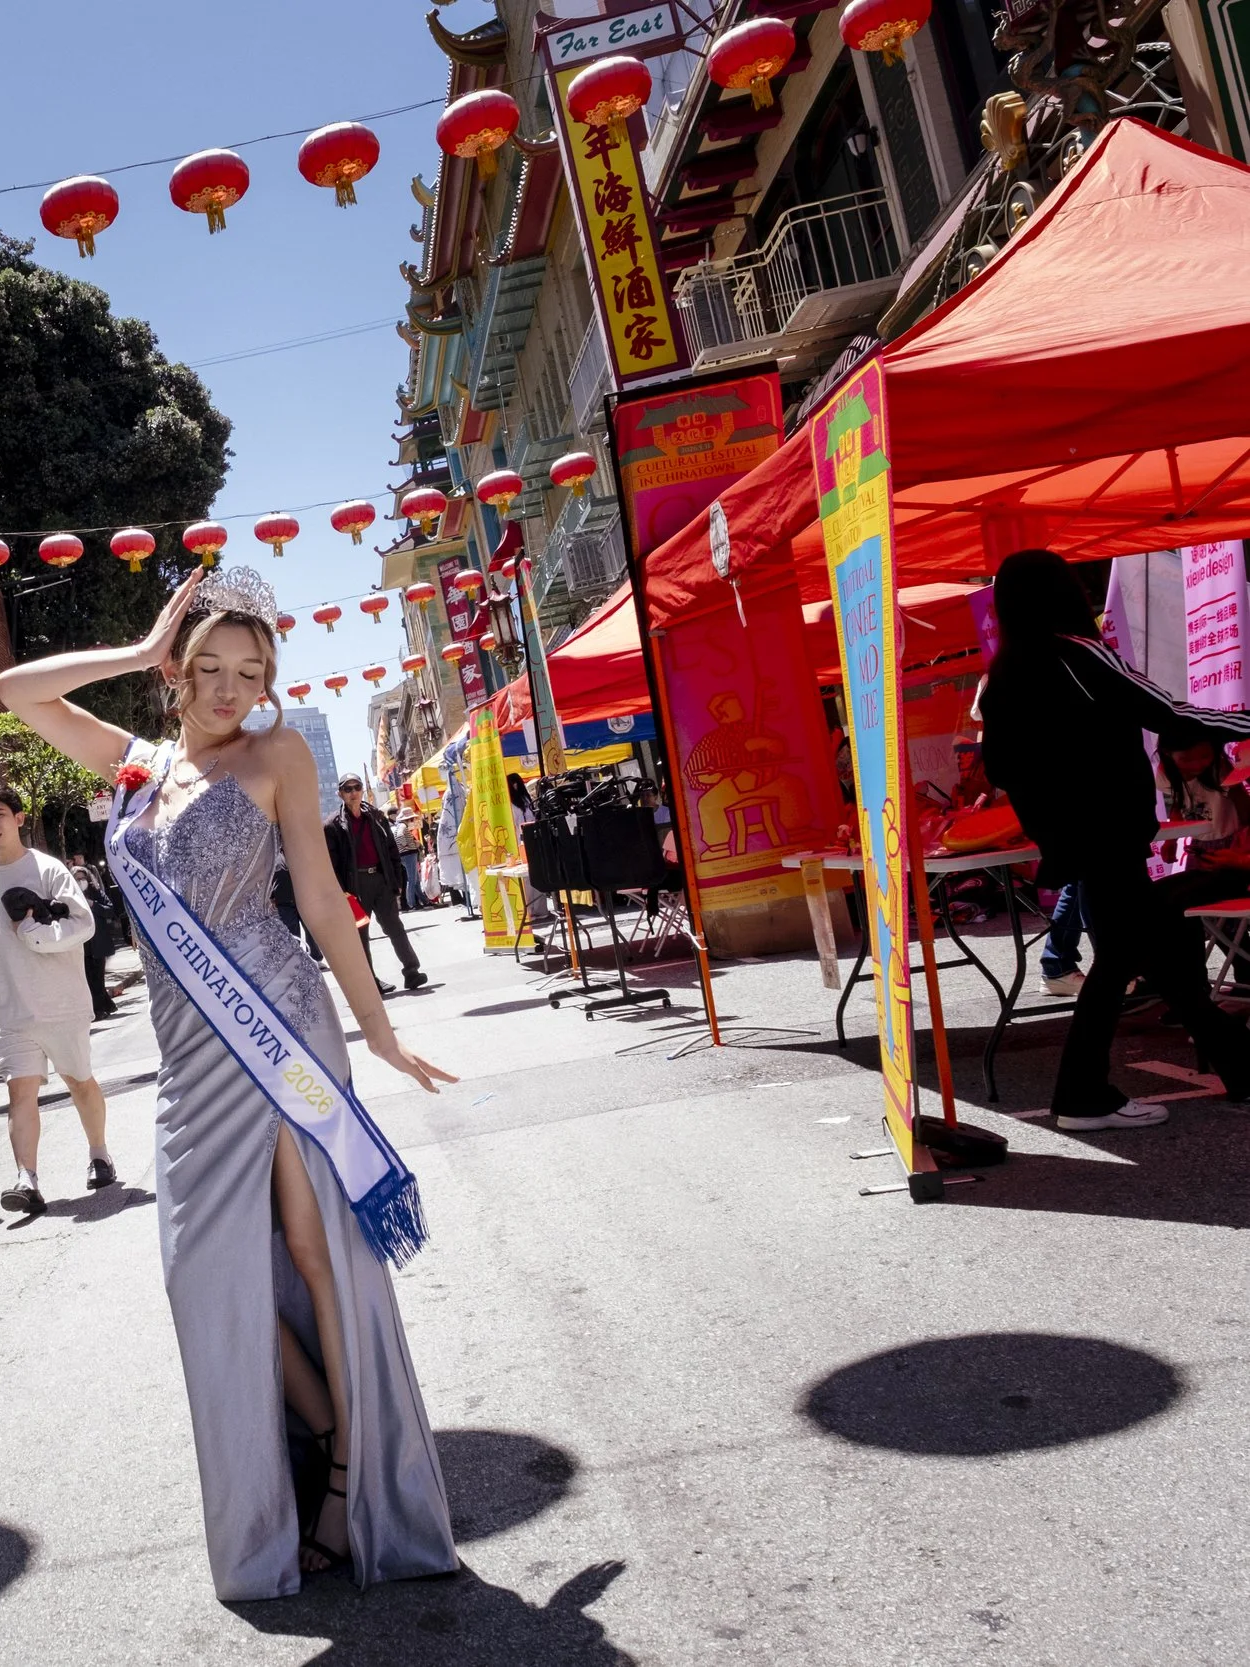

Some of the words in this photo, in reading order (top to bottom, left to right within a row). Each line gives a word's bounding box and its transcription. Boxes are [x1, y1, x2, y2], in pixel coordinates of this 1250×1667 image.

[556, 32, 599, 58] Far
[608, 12, 664, 44] East
[637, 456, 698, 474] CULTURAL
[704, 444, 757, 461] FESTIVAL
[640, 478, 653, 488] IN
[656, 462, 735, 484] CHINATOWN
[122, 856, 166, 916] TEEN
[166, 921, 291, 1066] CHINATOWN
[283, 1063, 334, 1114] 2026
